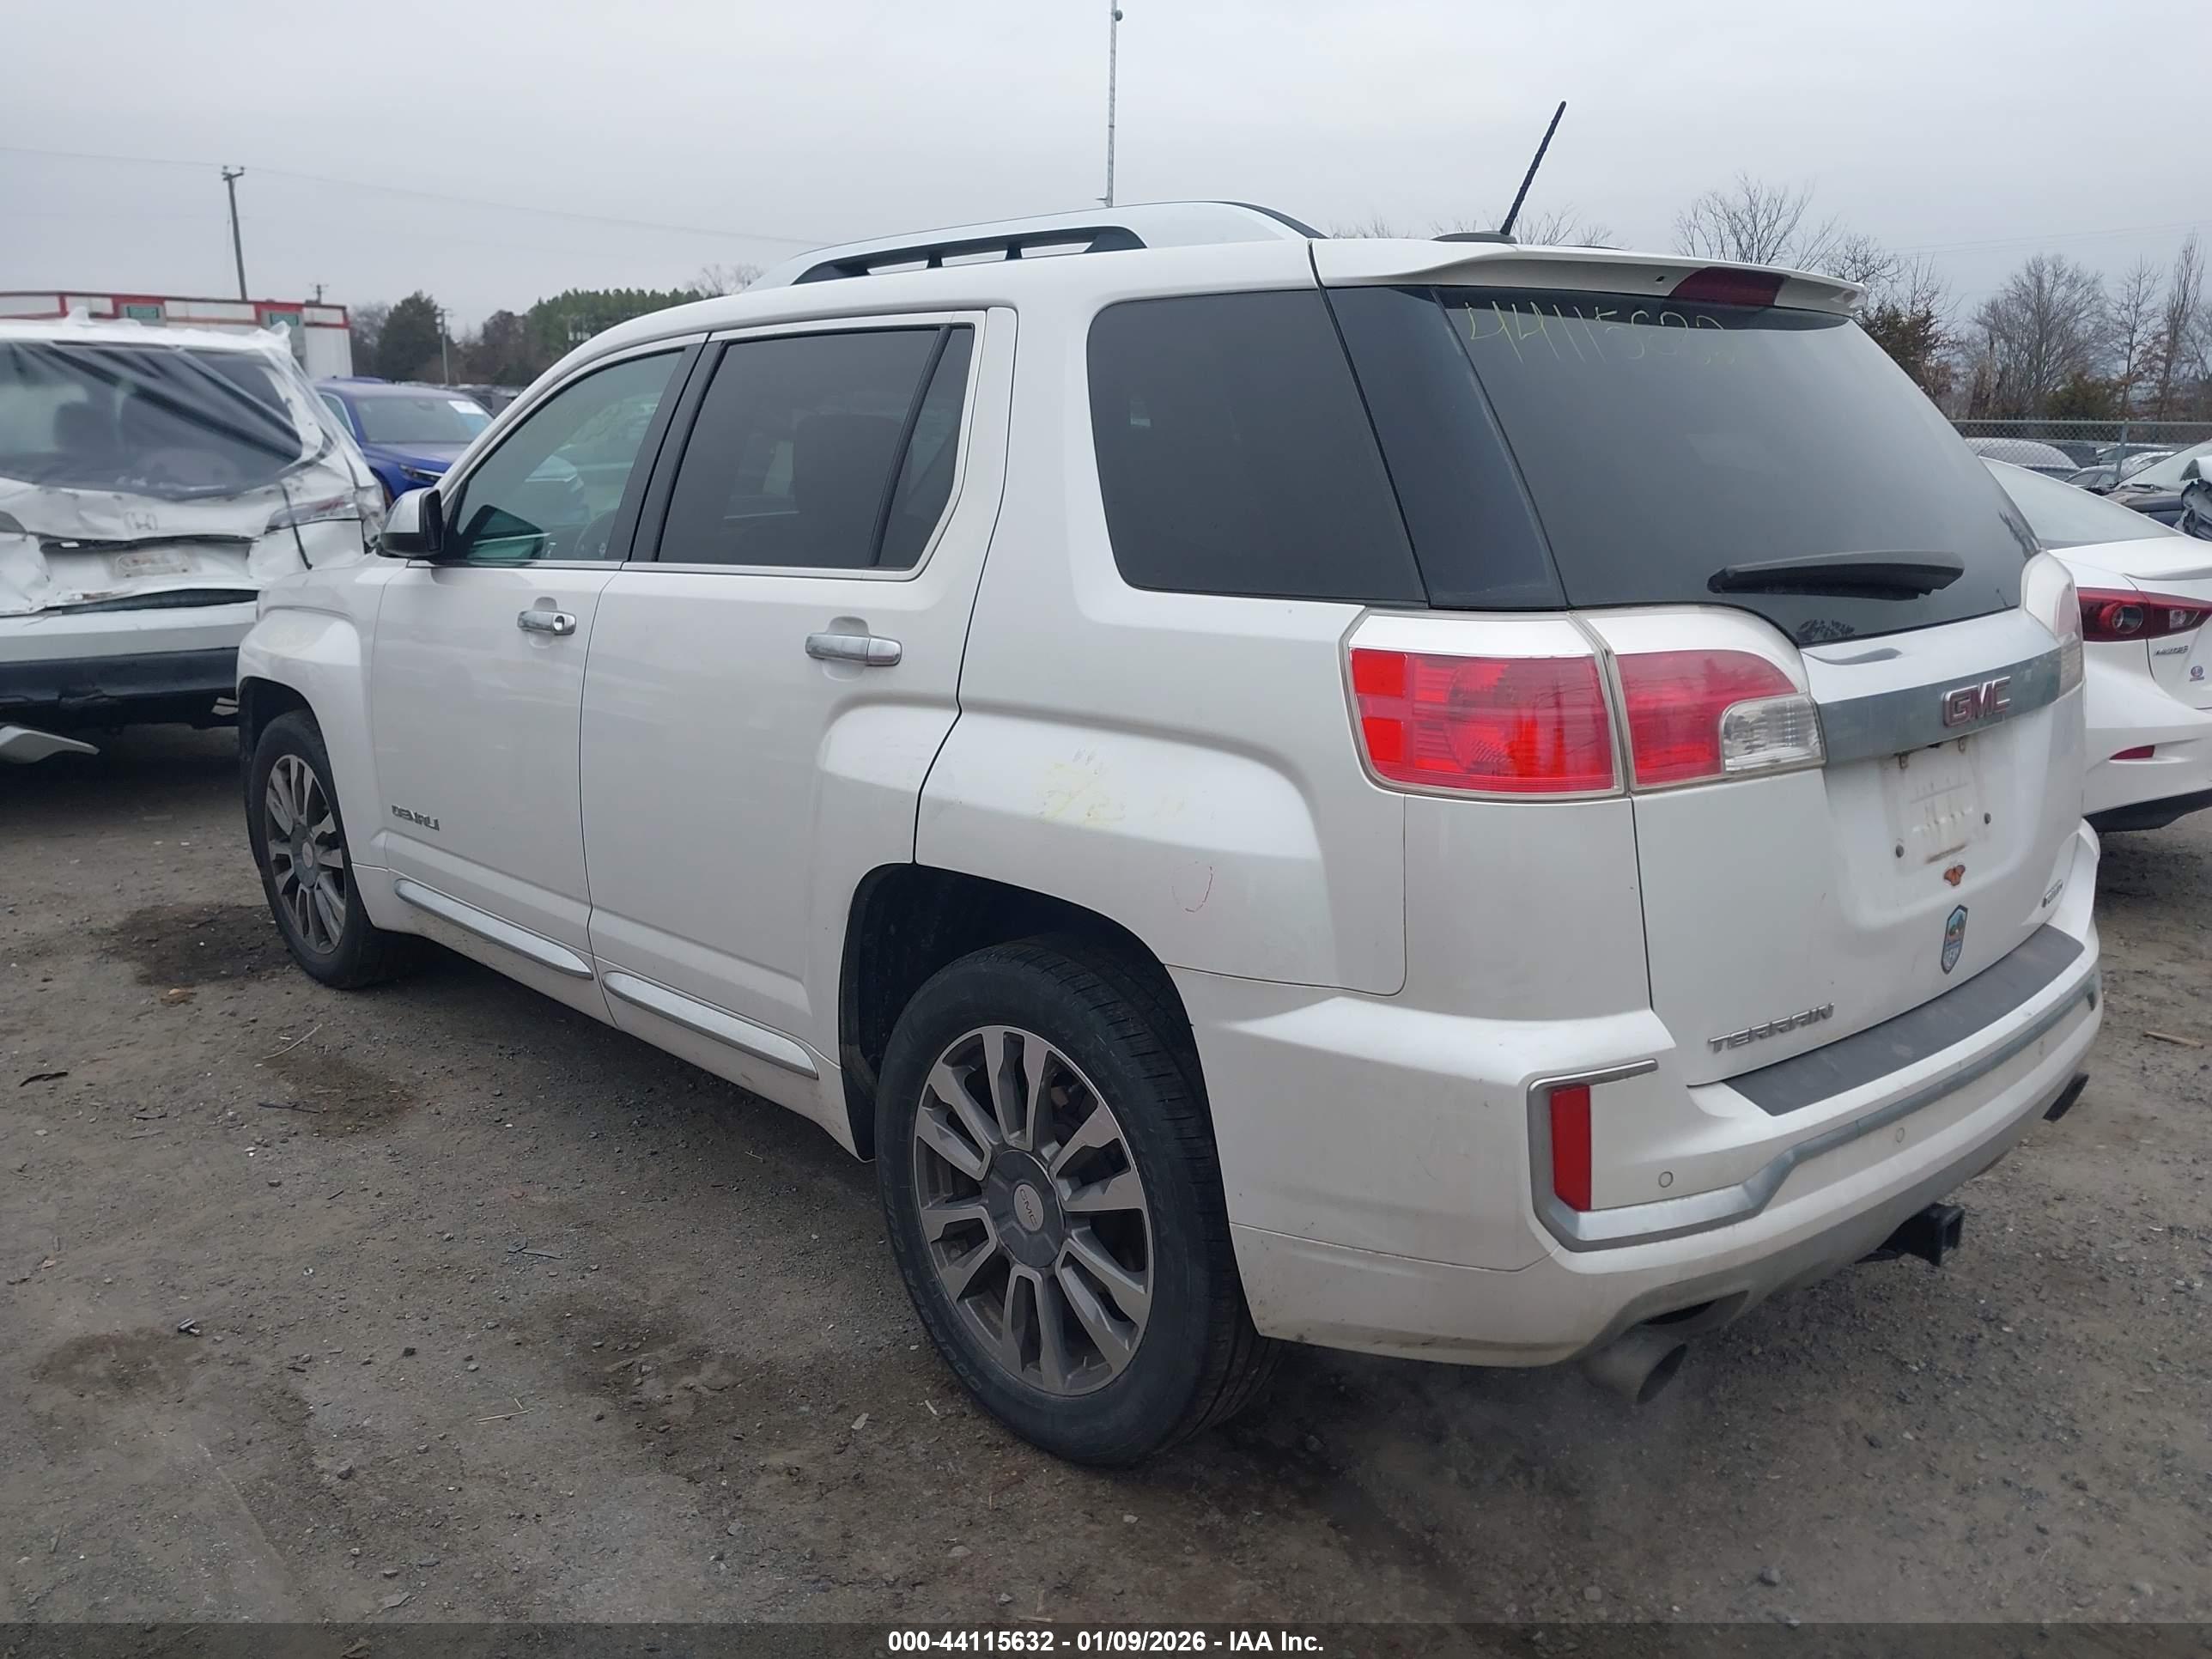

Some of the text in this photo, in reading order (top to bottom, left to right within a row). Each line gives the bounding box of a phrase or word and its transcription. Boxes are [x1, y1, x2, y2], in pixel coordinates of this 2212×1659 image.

[1942, 675, 2012, 727] GMC
[1707, 1002, 1834, 1054] TERRAIN
[1020, 1188, 1037, 1227] GMC
